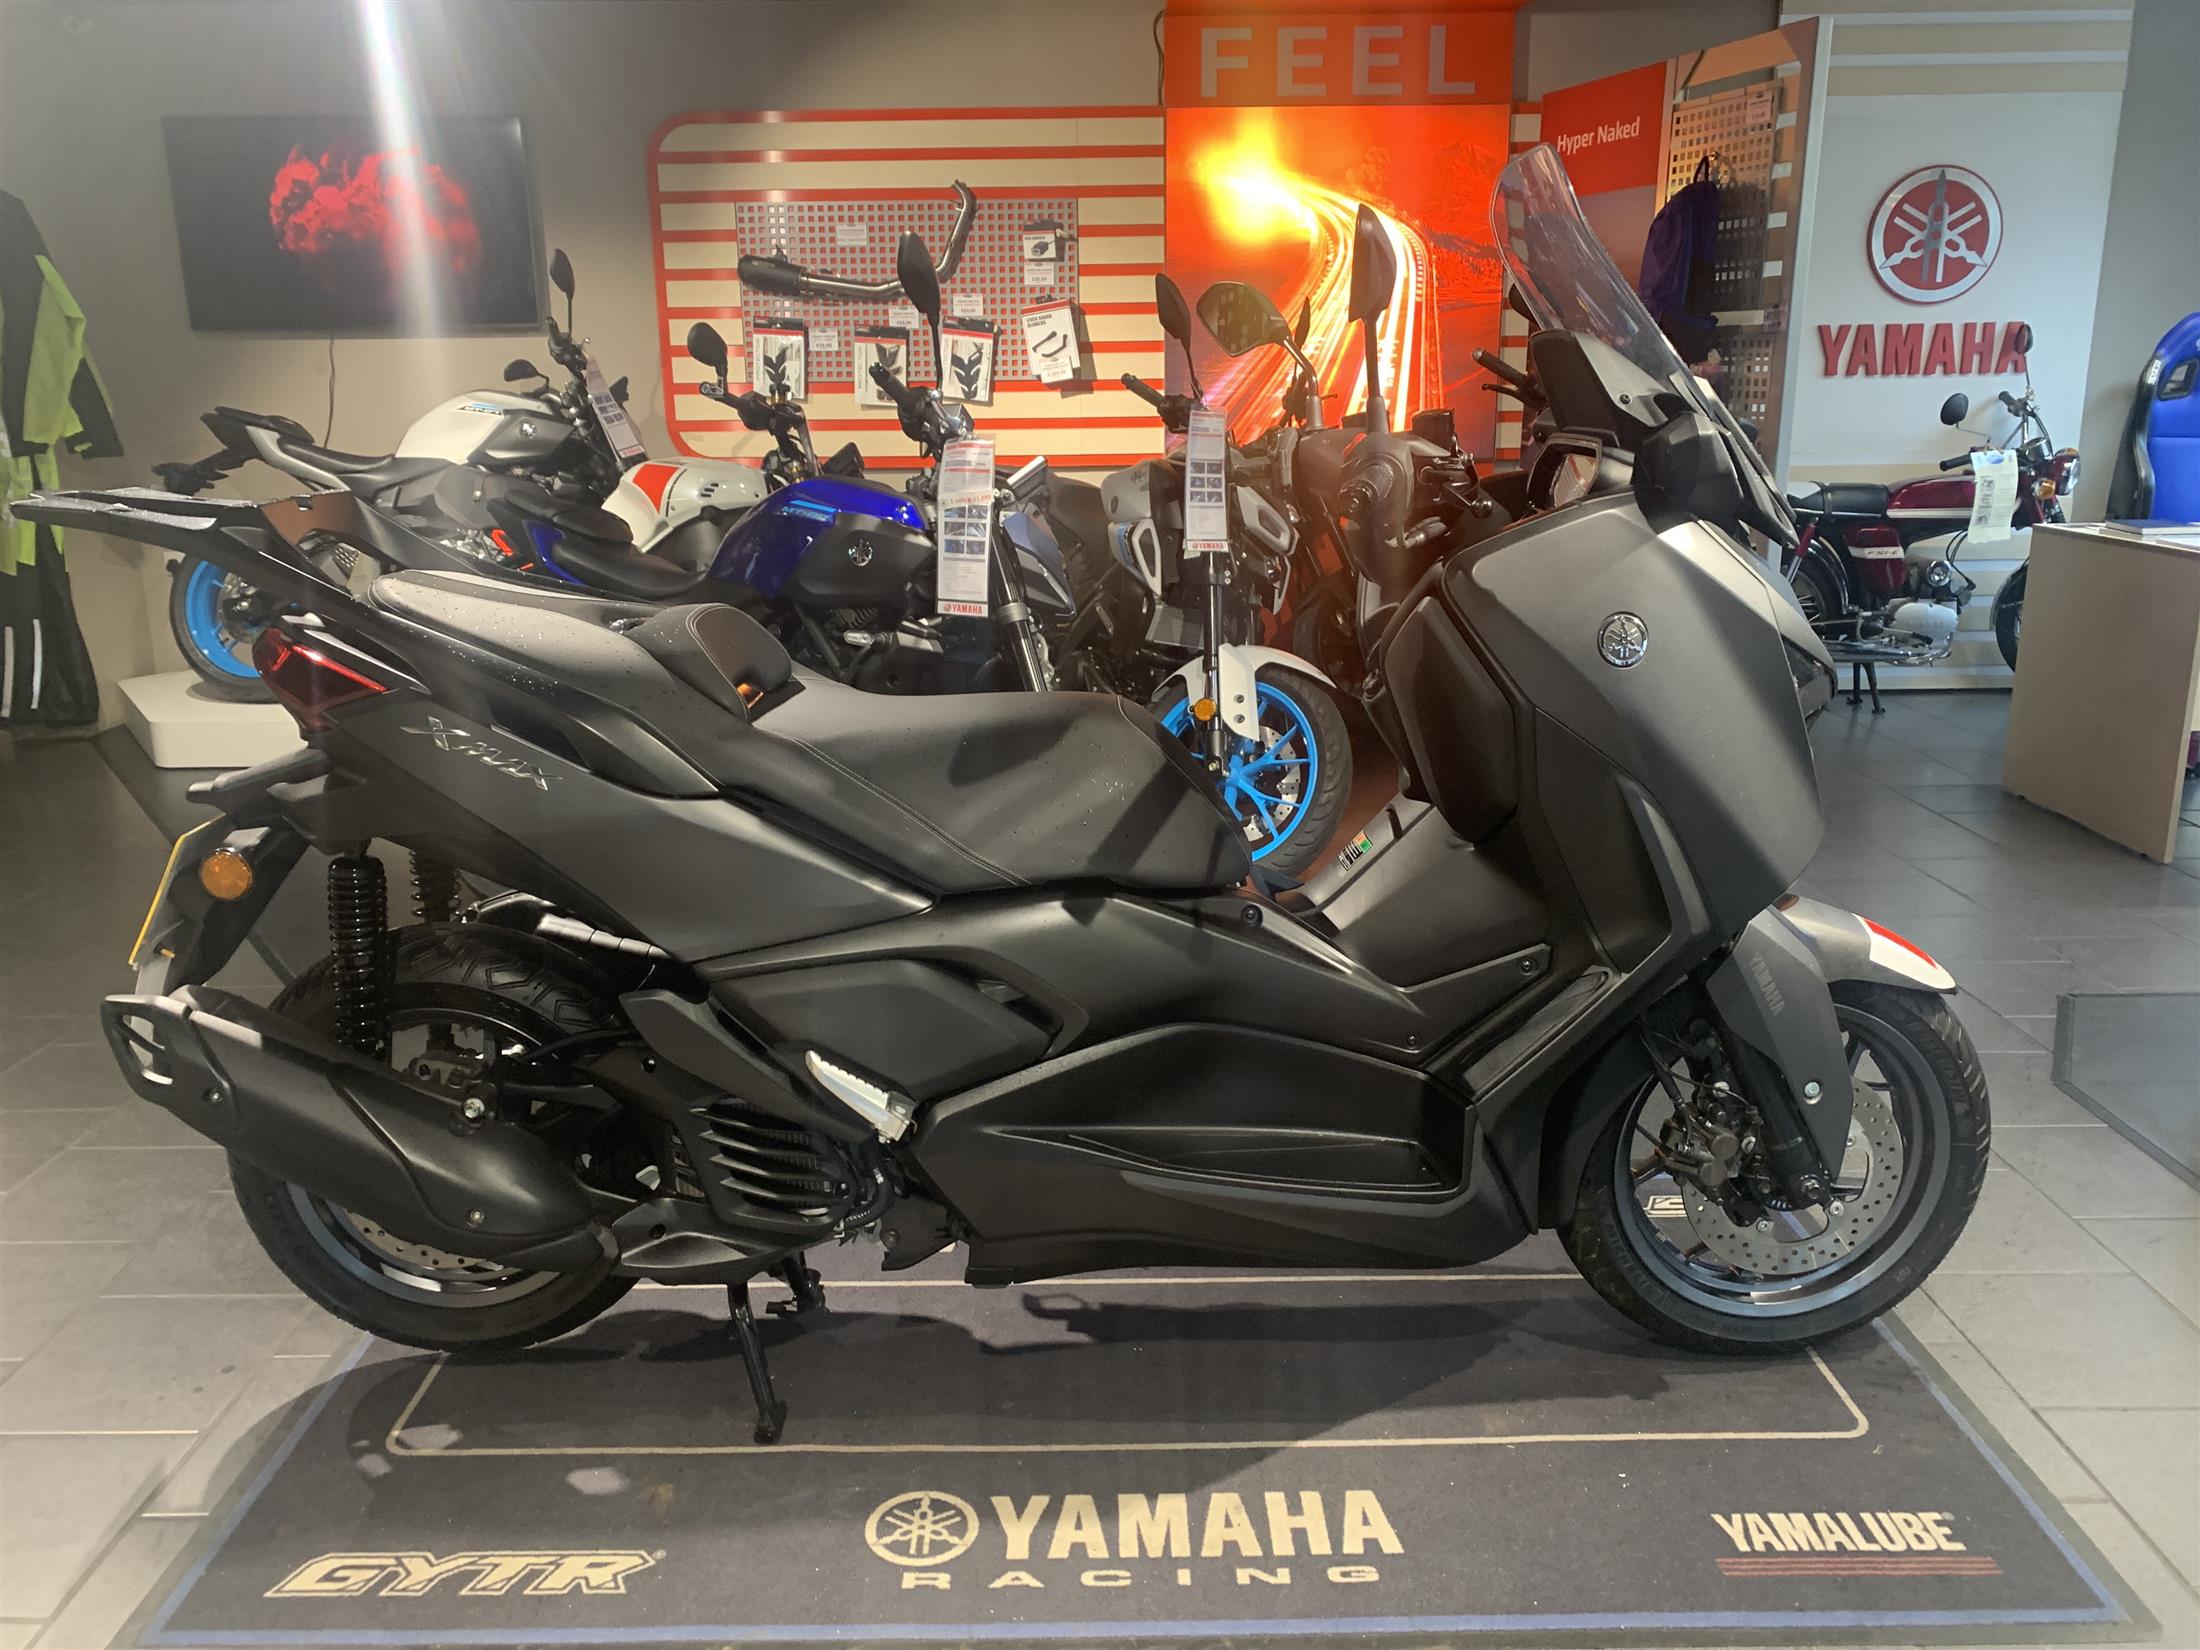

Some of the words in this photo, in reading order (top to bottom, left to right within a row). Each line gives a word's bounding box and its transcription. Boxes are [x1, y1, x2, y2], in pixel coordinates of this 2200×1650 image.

[1201, 25, 1476, 97] FEEL
[1557, 134, 1595, 156] Hyper
[1597, 116, 1640, 144] Naked
[1818, 322, 2027, 377] YAMAHA
[1198, 541, 1224, 549] YAMAHA
[952, 603, 983, 614] YAMAHA
[1748, 953, 1785, 1016] YAMAHA
[989, 1489, 1405, 1560] YAMAHA
[1710, 1511, 1968, 1553] YAMALUBE
[900, 1565, 1381, 1591] RACING
